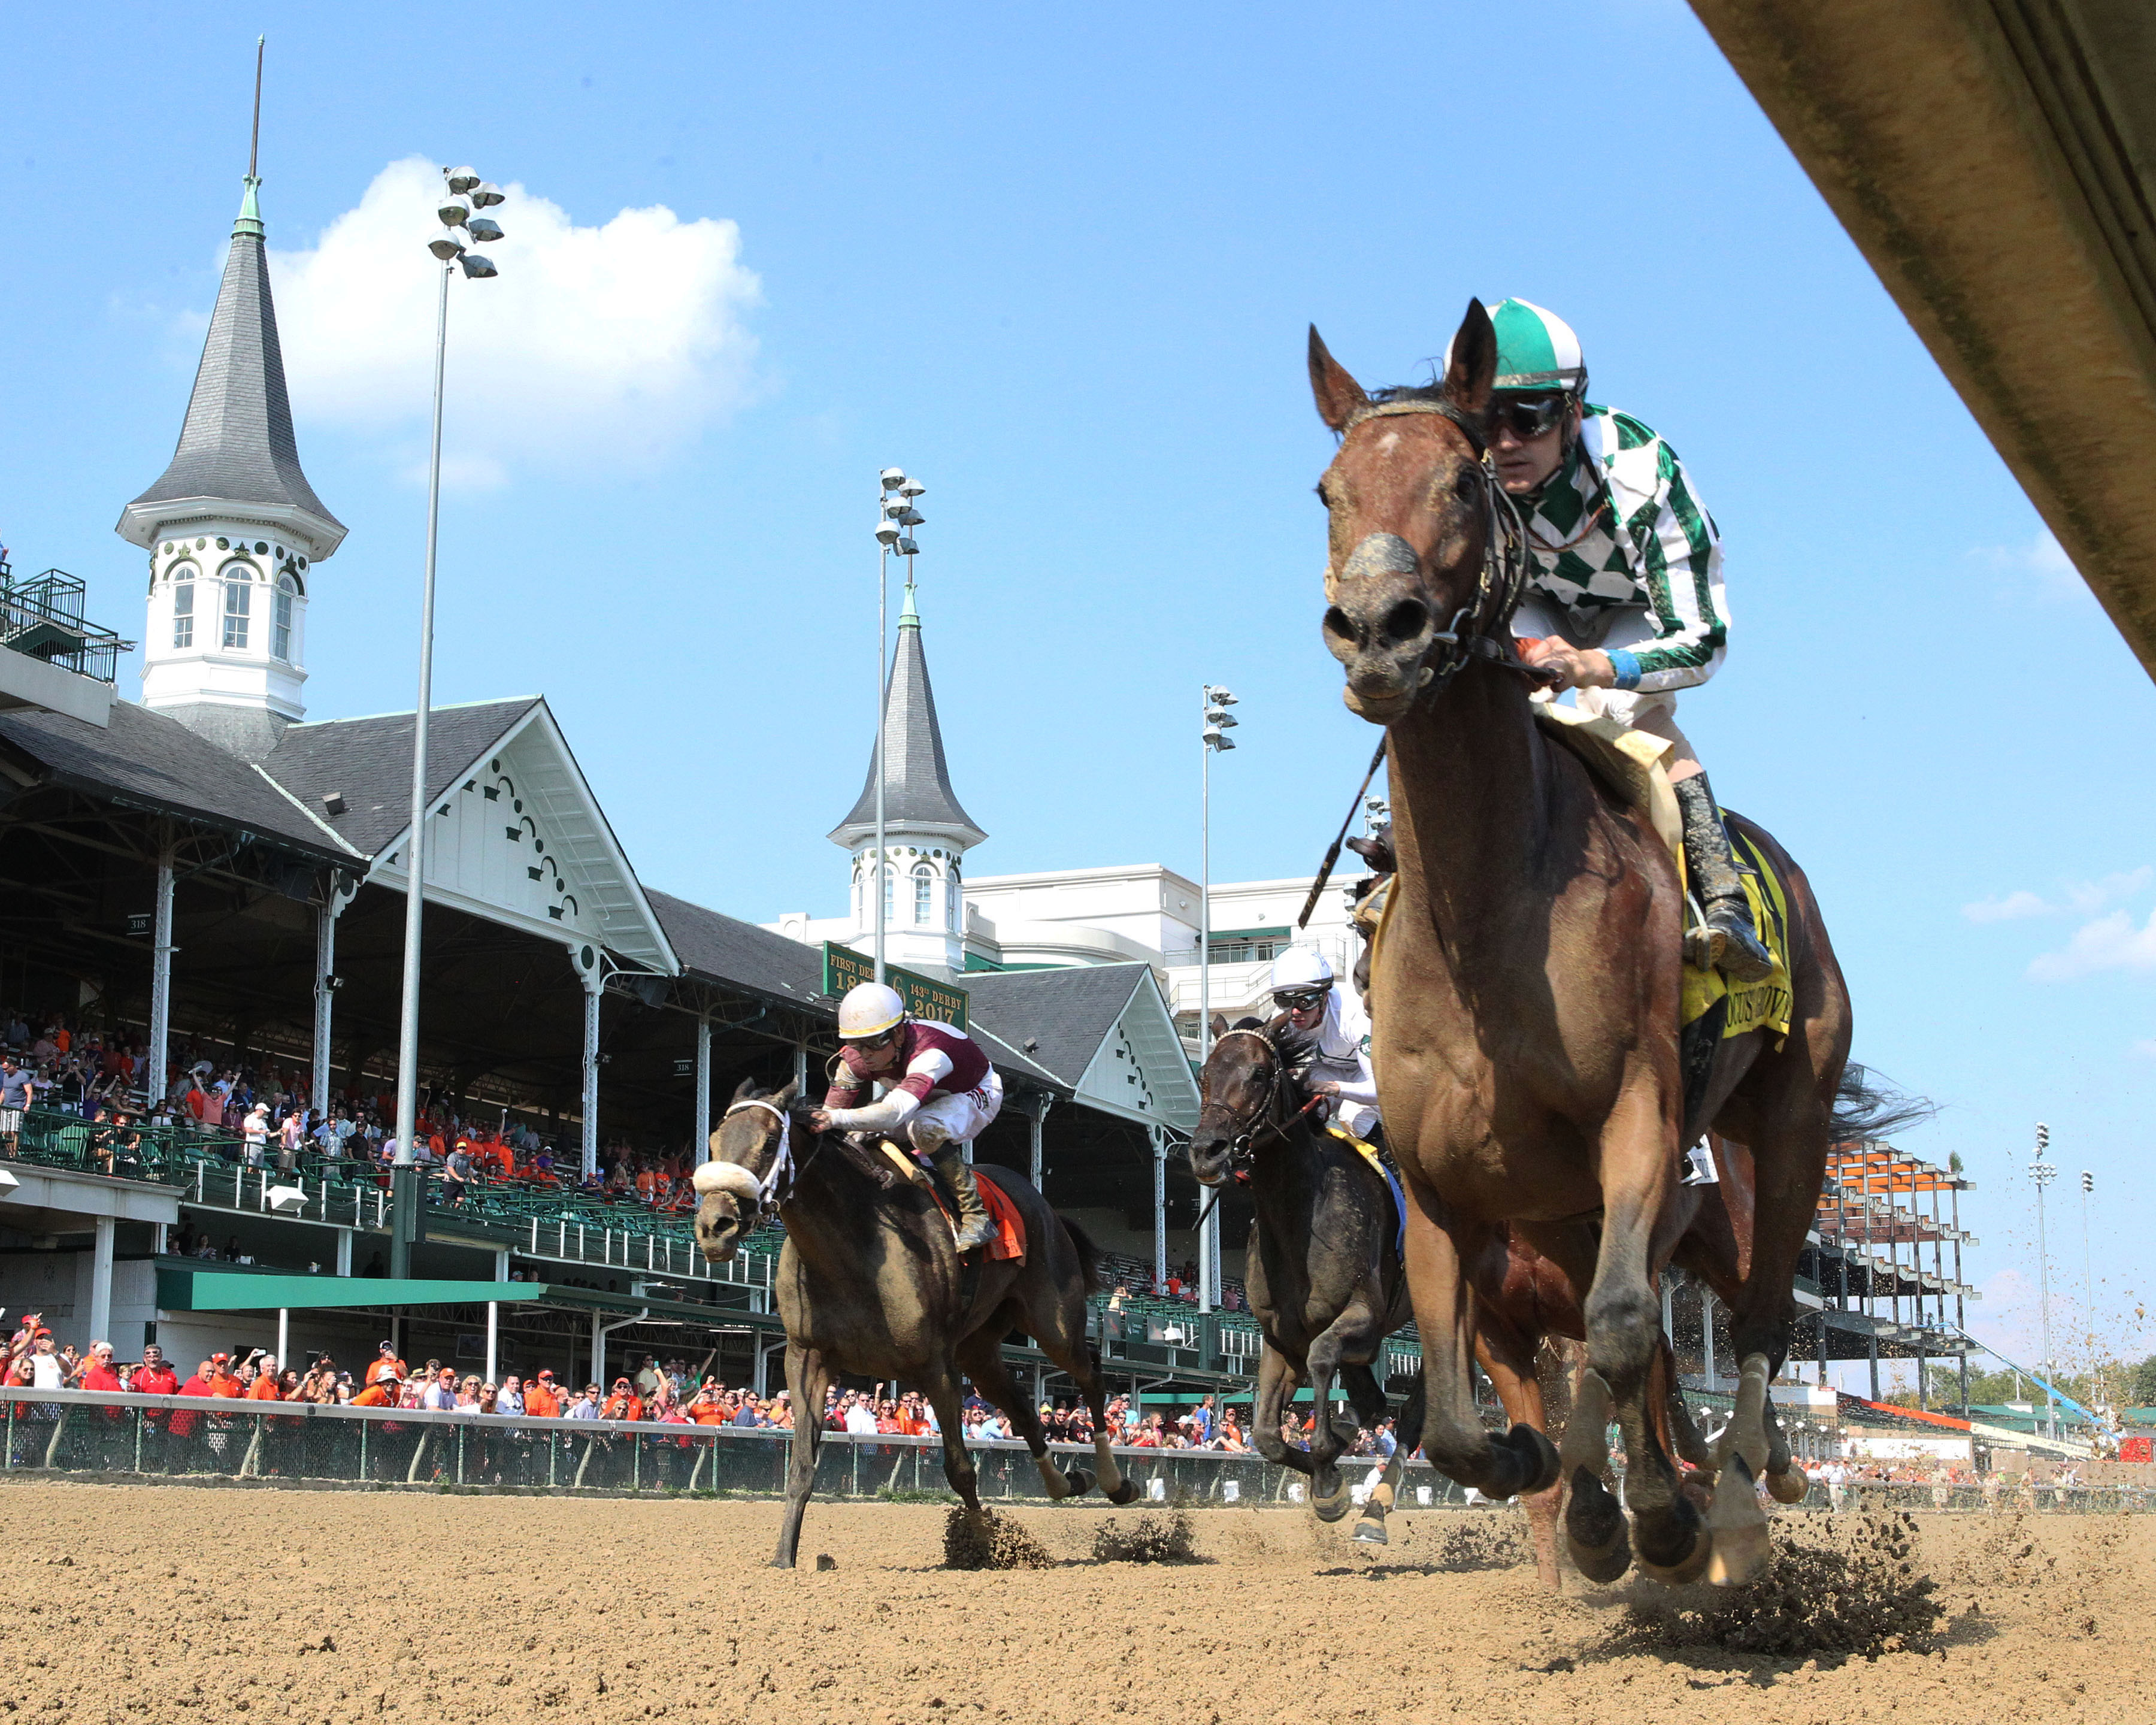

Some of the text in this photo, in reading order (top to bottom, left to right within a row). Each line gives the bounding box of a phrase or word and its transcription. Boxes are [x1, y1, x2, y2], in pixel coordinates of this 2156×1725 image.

[131, 919, 146, 928] 318
[830, 954, 874, 980] FIRST DER
[915, 999, 954, 1024] 2017
[932, 991, 961, 1010] DERBY
